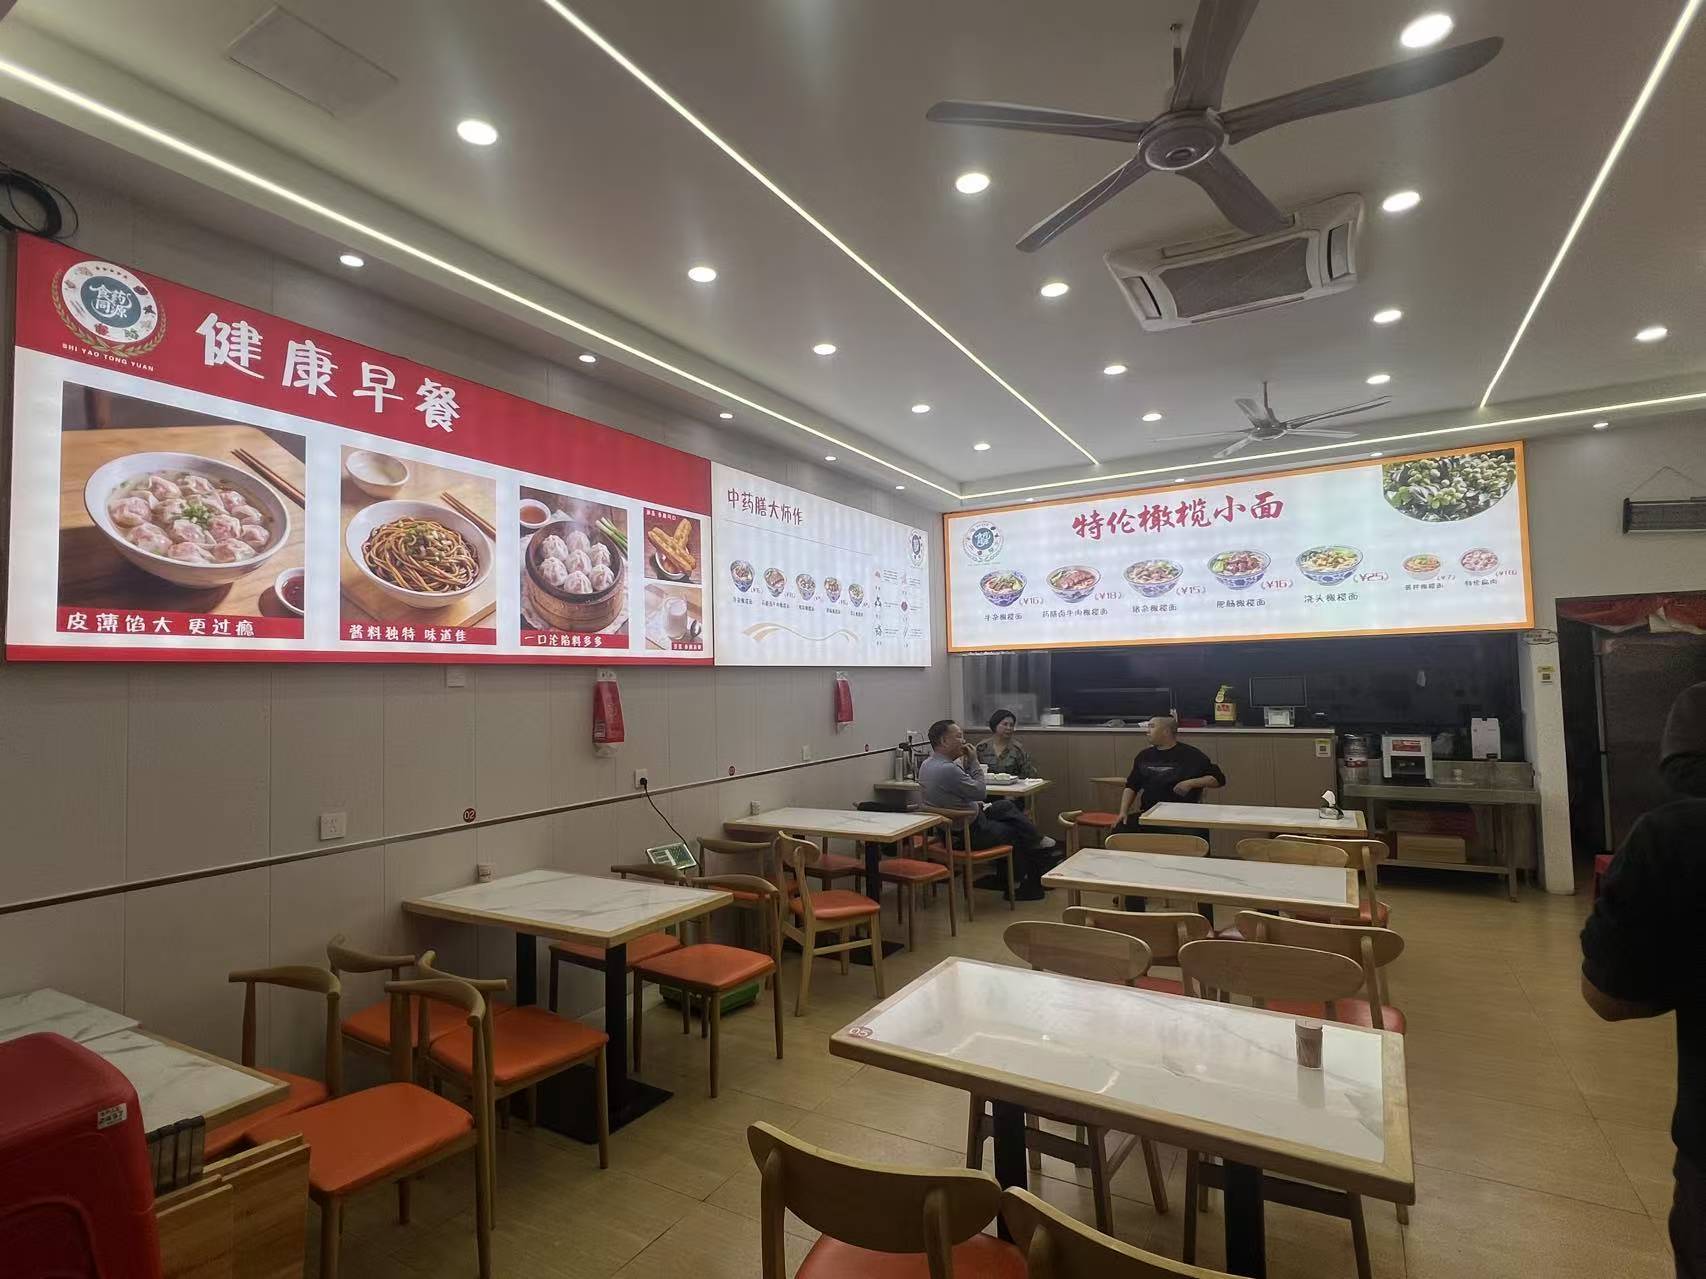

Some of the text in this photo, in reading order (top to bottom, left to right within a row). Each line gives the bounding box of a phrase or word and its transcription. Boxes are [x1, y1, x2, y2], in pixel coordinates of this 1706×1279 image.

[89, 284, 132, 307] 食药
[91, 297, 128, 318] 同源
[62, 343, 154, 372] SHI YAO TONG YUAN
[195, 312, 461, 433] 健康早餐
[727, 487, 803, 525] 中药膳大师作
[1072, 491, 1284, 540] 特伦橄榄小面
[66, 611, 256, 637] 皮薄馅大 更过瘾
[349, 624, 467, 642] 酱料独特 味道佳
[464, 810, 475, 820] 02
